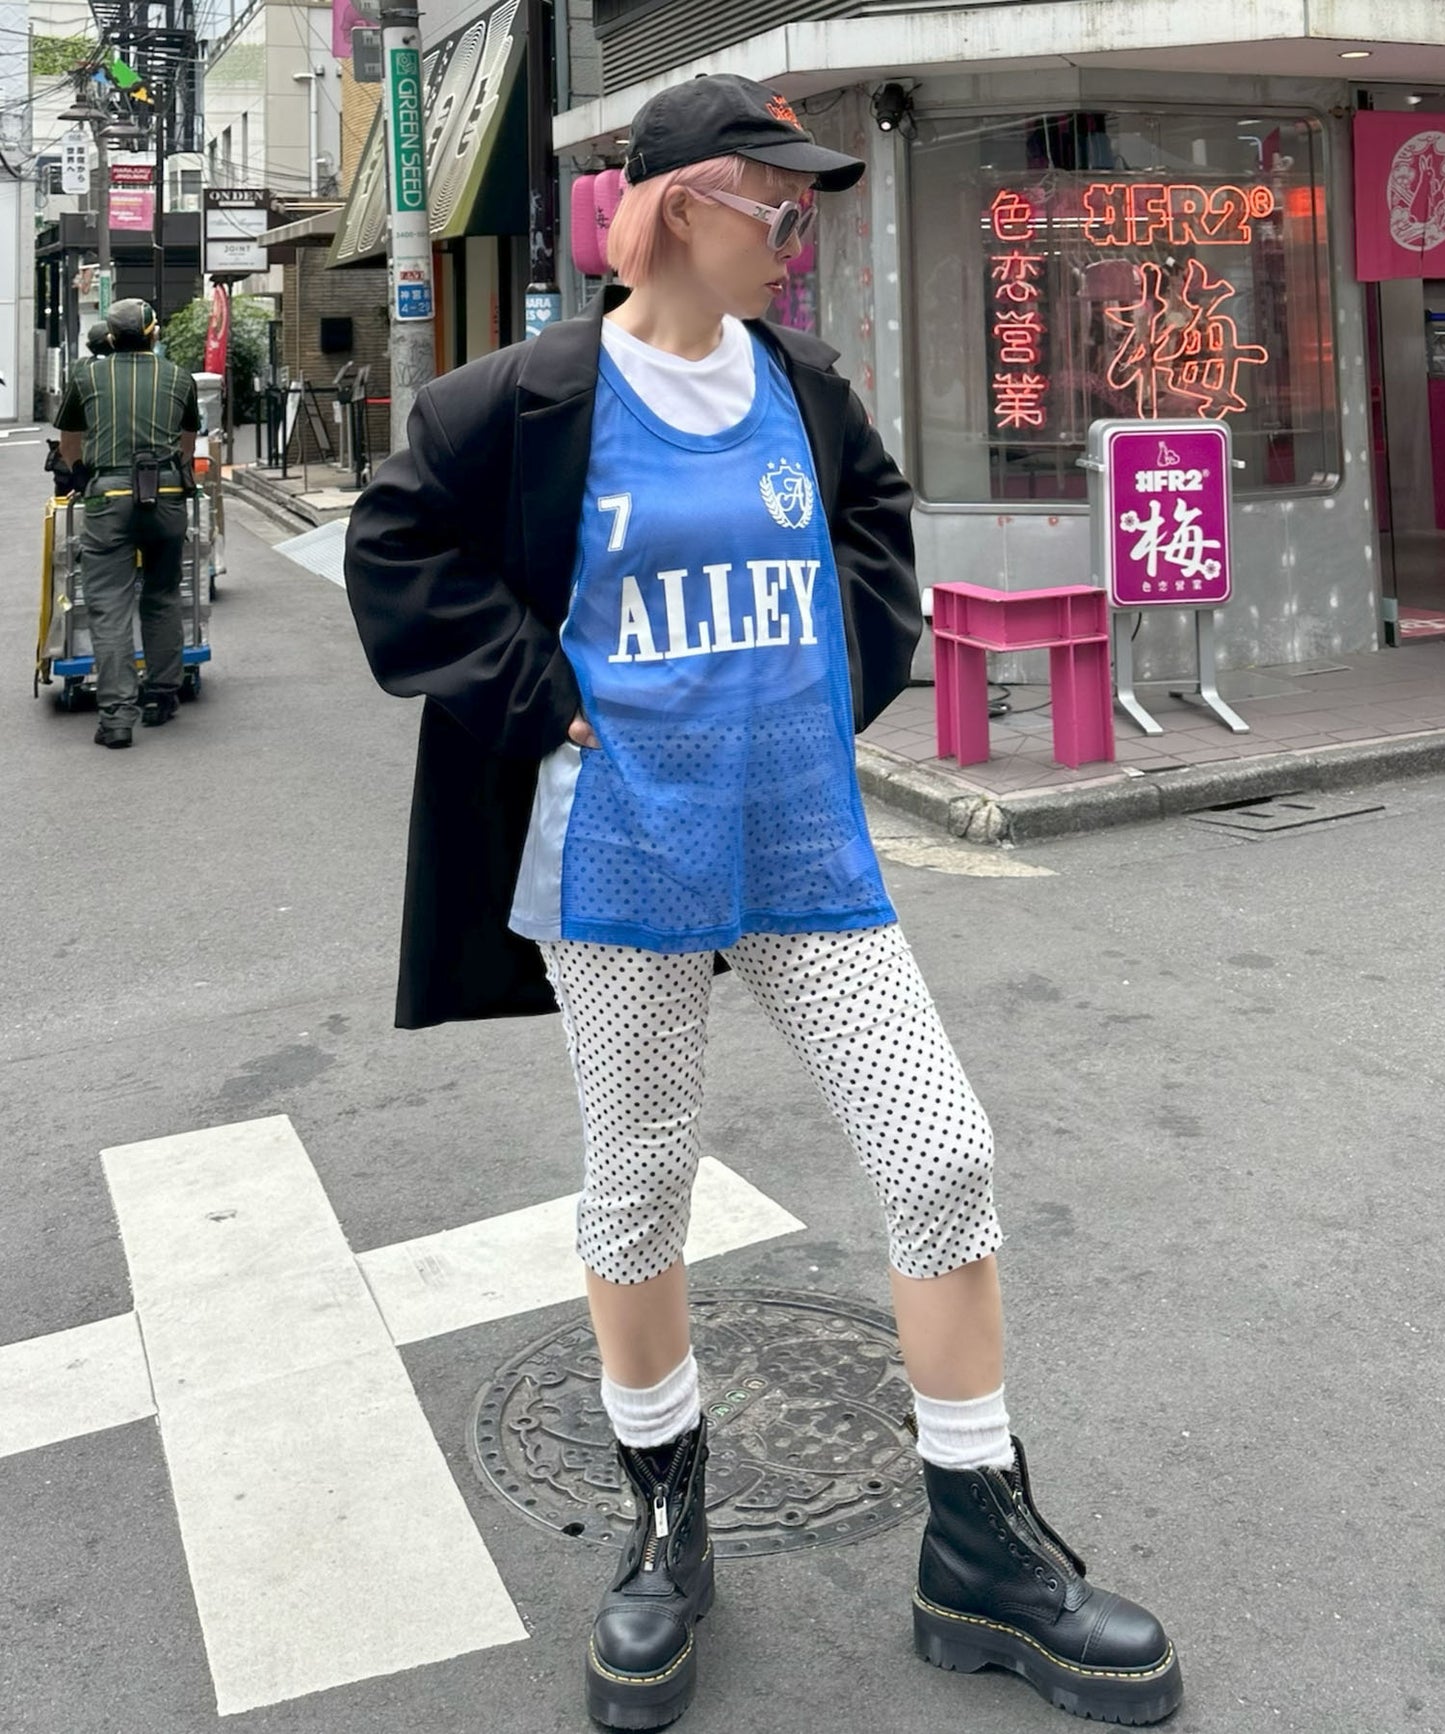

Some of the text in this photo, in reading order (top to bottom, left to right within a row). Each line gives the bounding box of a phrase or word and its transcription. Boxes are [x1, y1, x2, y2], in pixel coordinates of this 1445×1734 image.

[398, 78, 419, 149] GREEN
[209, 191, 264, 200] ONDEN
[401, 153, 422, 207] SEED
[991, 189, 1046, 429] 色恋営業
[1104, 258, 1269, 421] 梅
[598, 492, 632, 552] 7
[1126, 498, 1221, 578] 梅
[608, 560, 821, 663] ALLEY
